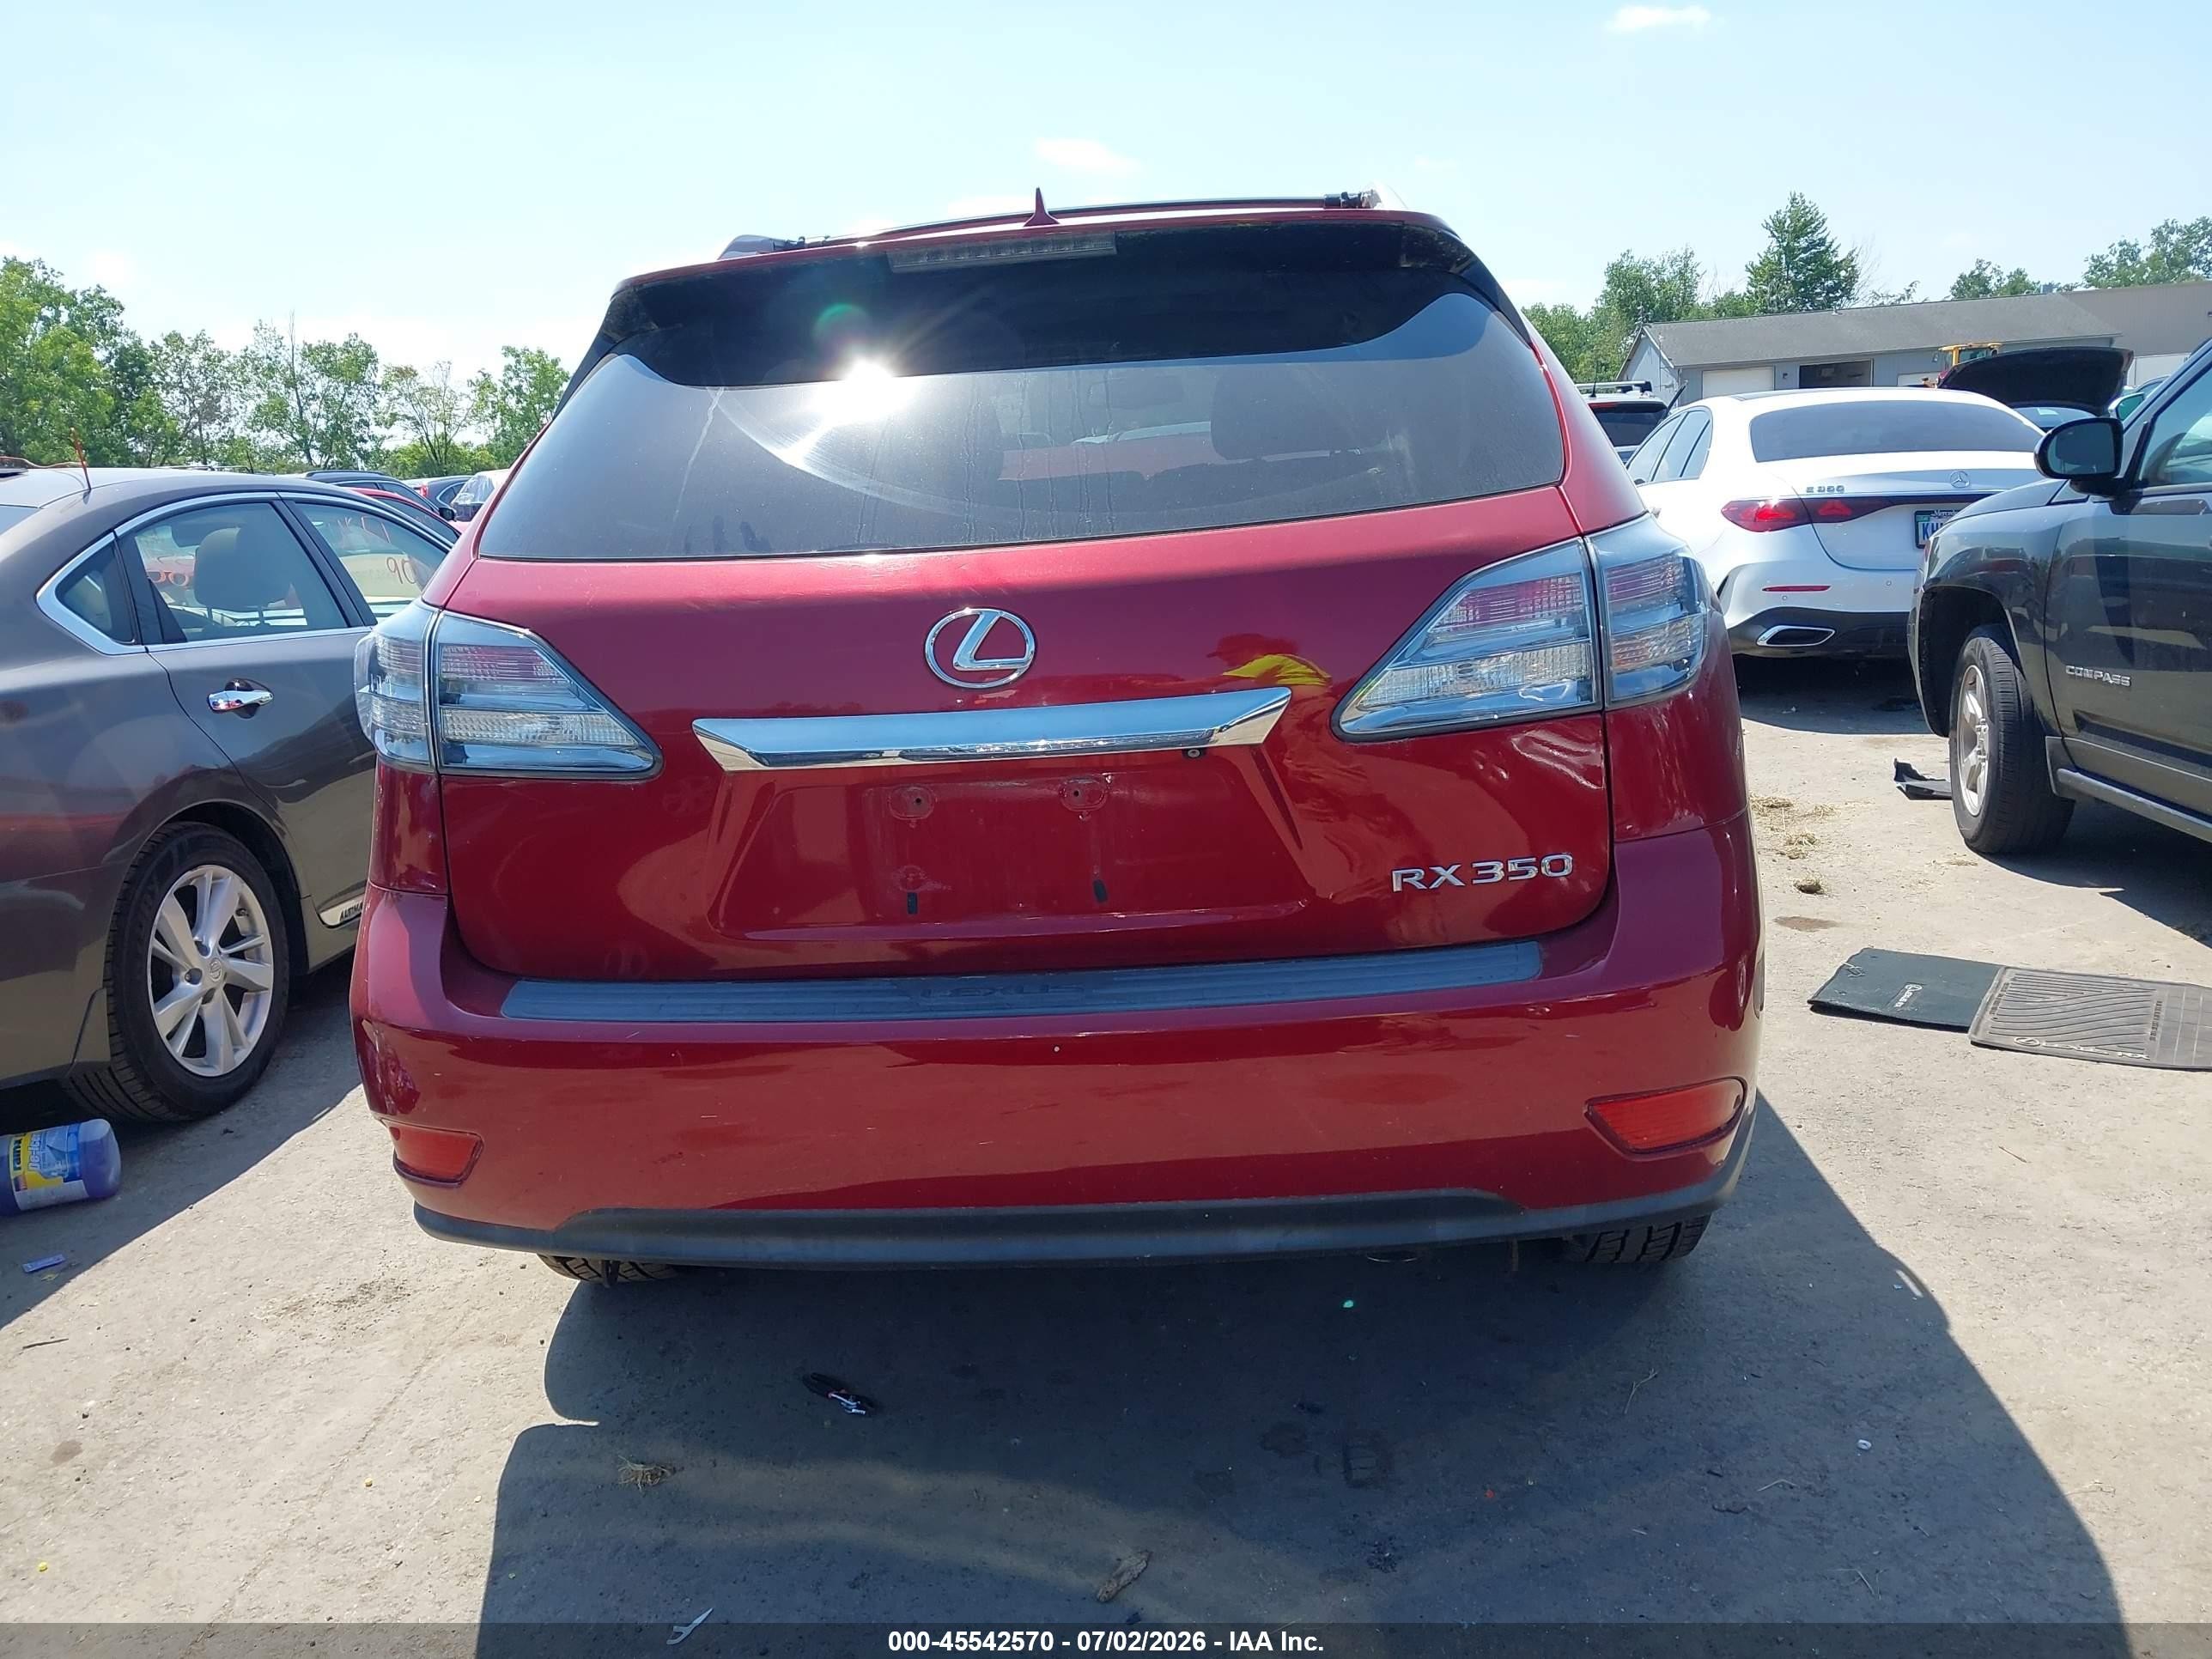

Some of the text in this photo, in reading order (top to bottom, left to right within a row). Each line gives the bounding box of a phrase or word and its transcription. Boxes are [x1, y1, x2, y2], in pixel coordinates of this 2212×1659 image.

[2065, 665, 2130, 687] COMPASS
[1391, 854, 1573, 892] RX 350
